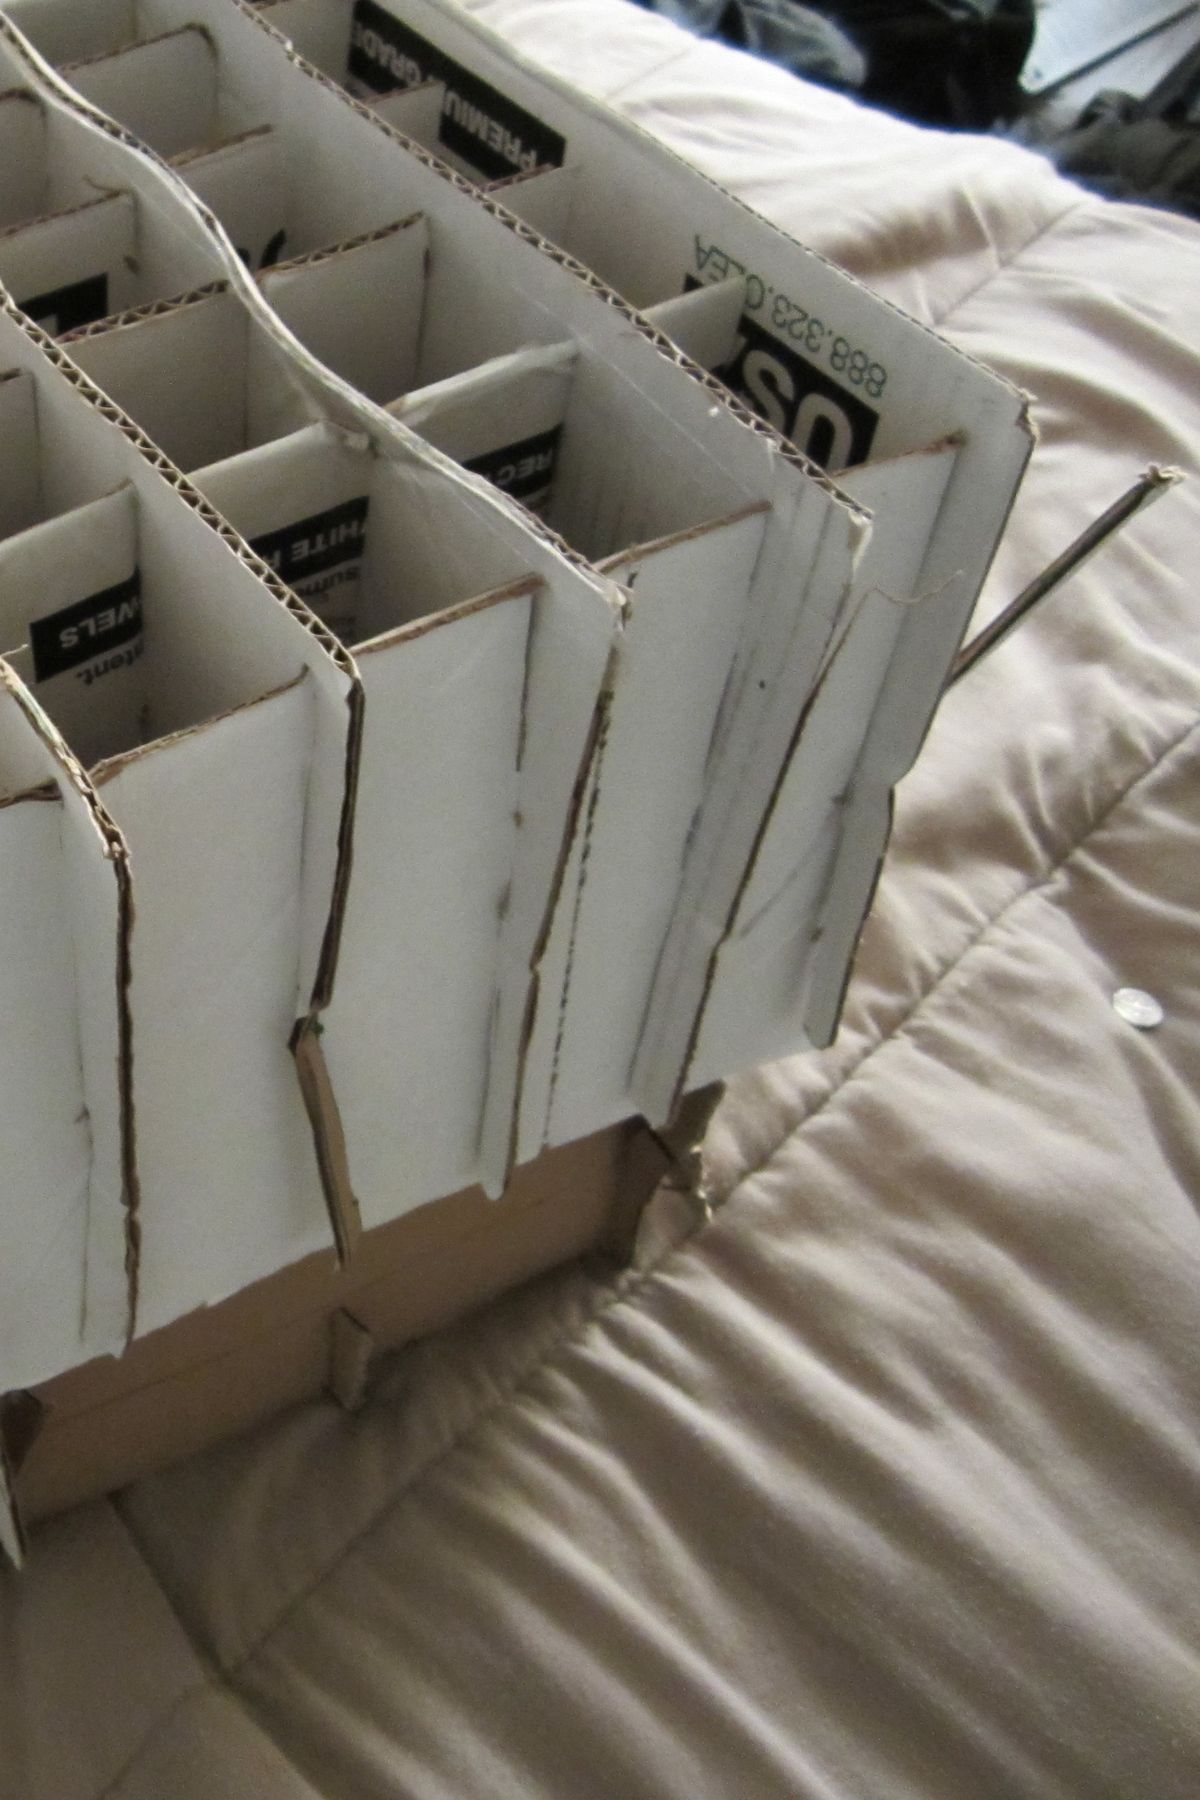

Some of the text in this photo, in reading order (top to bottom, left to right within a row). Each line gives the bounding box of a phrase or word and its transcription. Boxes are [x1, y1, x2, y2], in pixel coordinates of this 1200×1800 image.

[428, 75, 538, 171] PREMIU
[485, 448, 553, 486] REC
[290, 519, 367, 562] HITE
